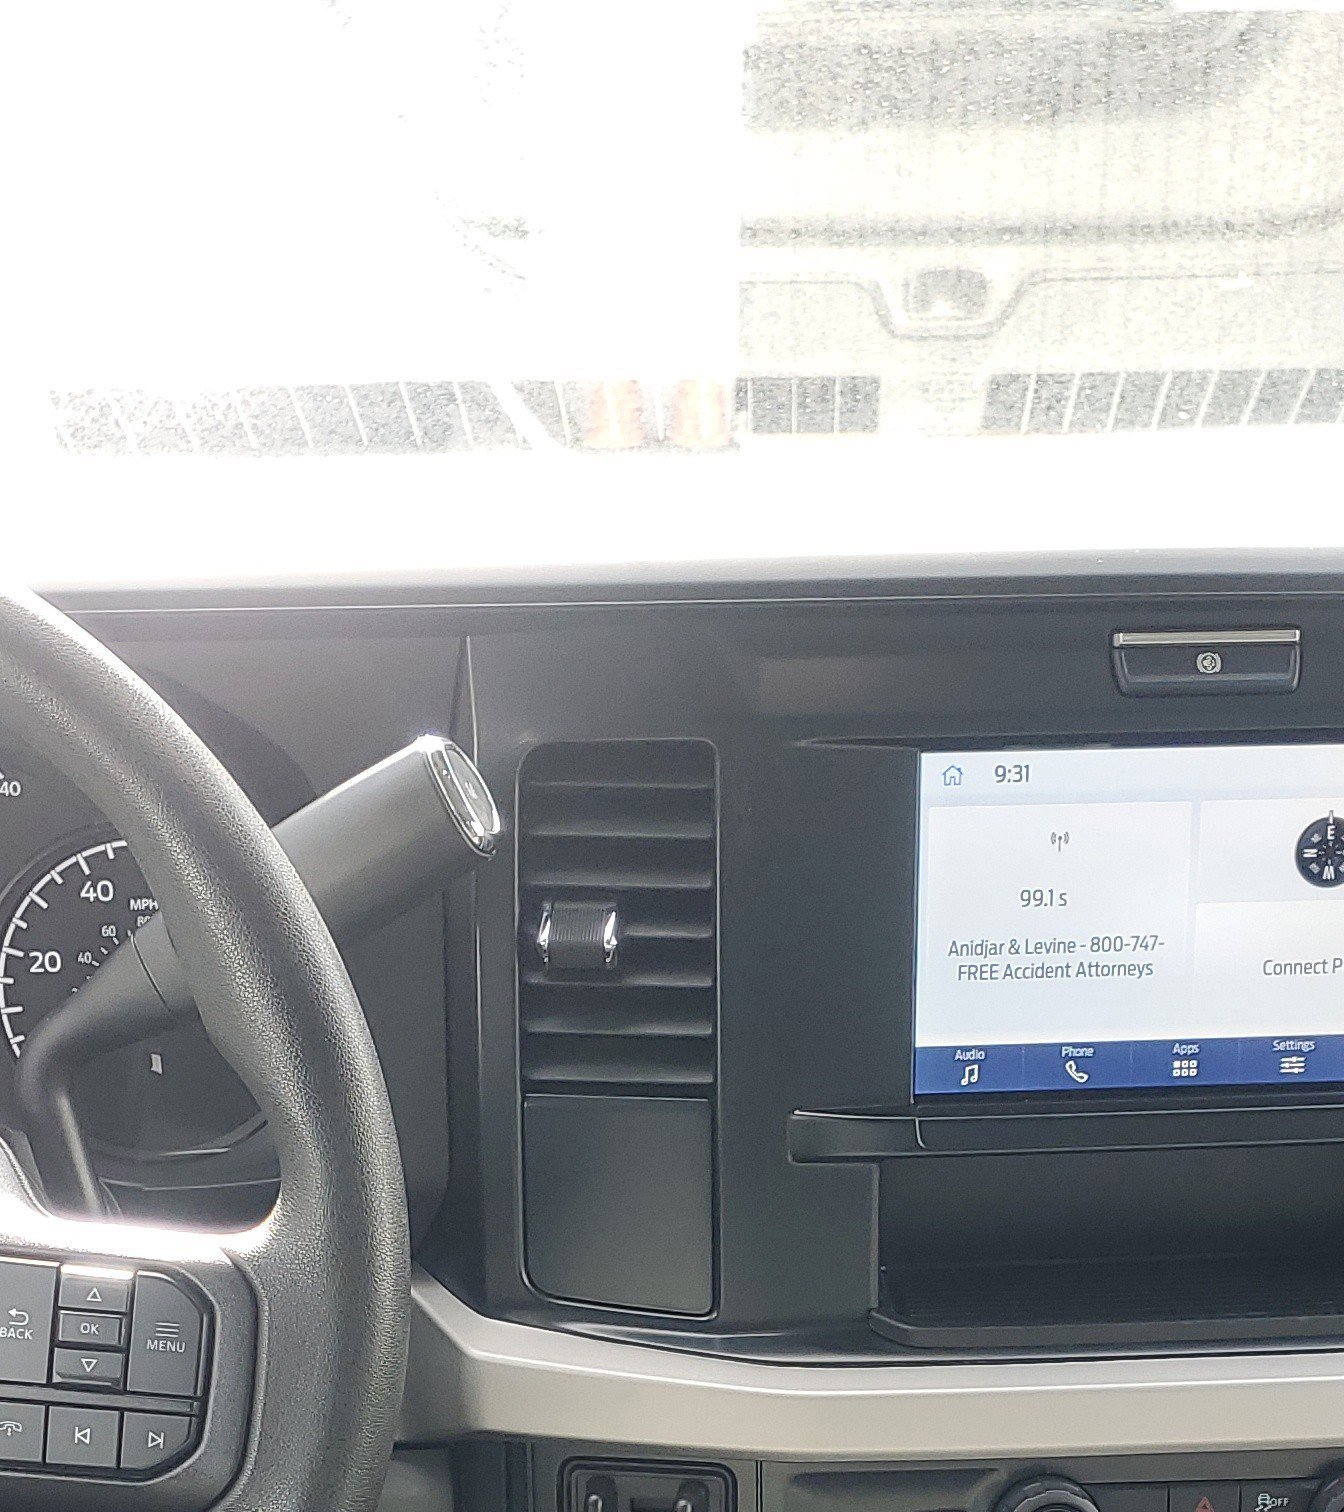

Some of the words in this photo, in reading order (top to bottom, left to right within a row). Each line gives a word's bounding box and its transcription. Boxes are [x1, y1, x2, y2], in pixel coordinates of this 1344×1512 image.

[995, 764, 1030, 783] 9:31
[80, 880, 115, 902] 40
[1020, 889, 1054, 907] 99.1
[130, 898, 159, 911] MPH
[101, 925, 117, 937] 60
[948, 939, 1005, 960] Anidjar
[1008, 938, 1021, 955] &
[1025, 937, 1076, 955] Levine
[1090, 935, 1165, 953] 800-747-
[29, 952, 62, 973] 20
[77, 951, 92, 964] 40
[958, 963, 999, 981] FREE
[1003, 962, 1071, 980] Accident
[1075, 961, 1153, 980] Attorneys
[1262, 958, 1328, 976] Connect
[1062, 1046, 1094, 1058] Phone
[1172, 1043, 1200, 1055] Apps
[1273, 1039, 1315, 1053] Settings
[954, 1049, 985, 1060] Audio
[0, 1326, 33, 1340] BACK
[80, 1322, 99, 1335] OK
[146, 1339, 186, 1353] MENU
[1270, 1497, 1289, 1507] OFF
